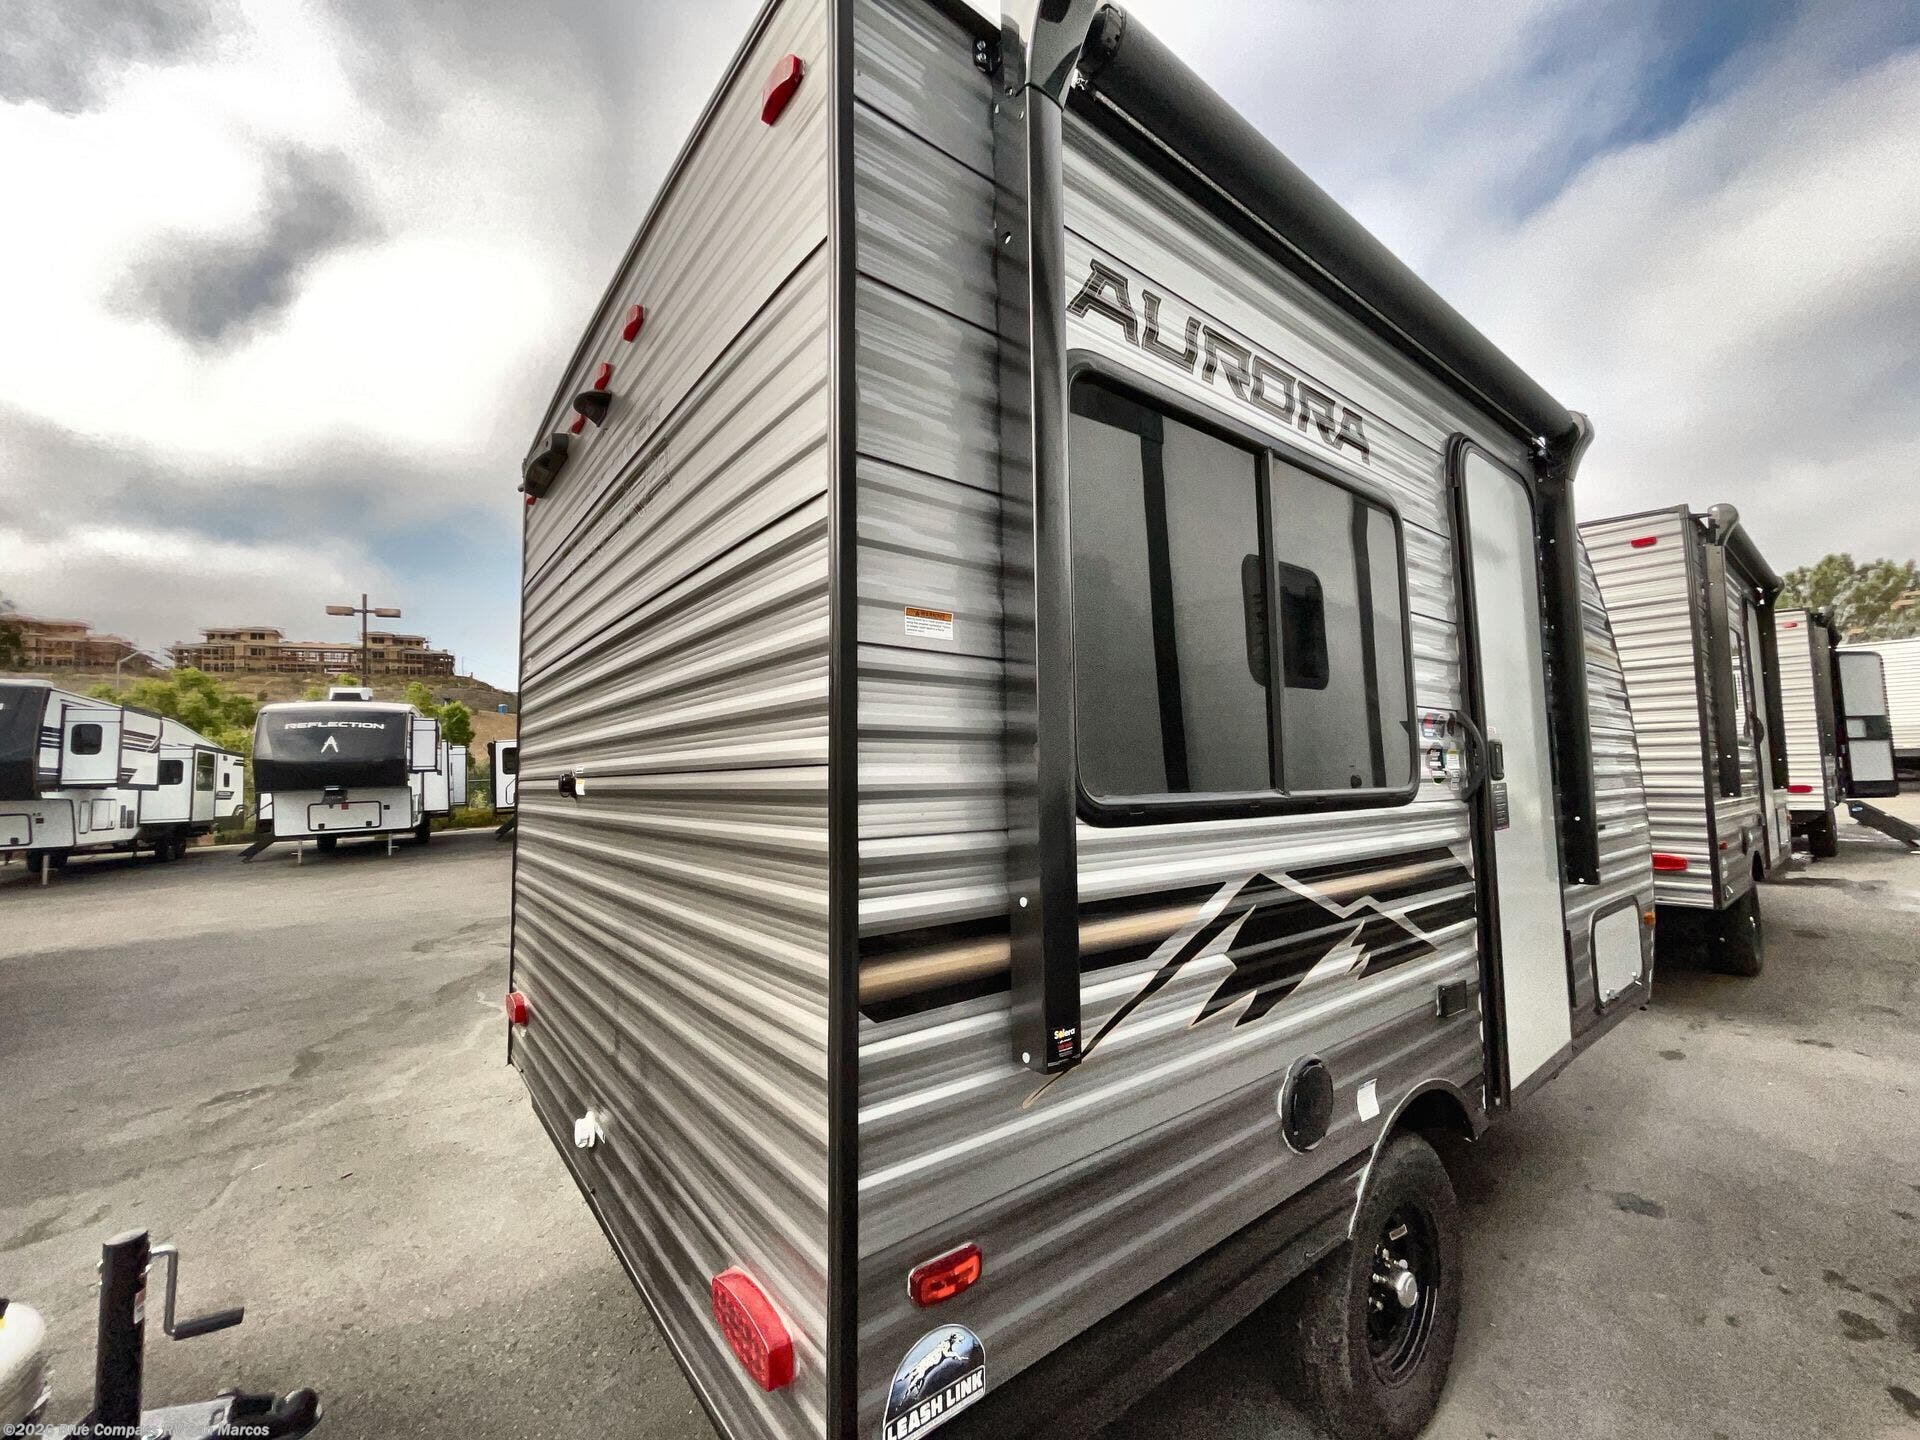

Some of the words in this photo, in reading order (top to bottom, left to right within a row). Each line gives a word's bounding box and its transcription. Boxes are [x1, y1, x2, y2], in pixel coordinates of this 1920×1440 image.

[1065, 258, 1371, 465] AURORA
[284, 721, 385, 730] REFLECTION
[1054, 1028, 1076, 1039] Solera
[886, 1395, 943, 1440] LEASH
[946, 1369, 983, 1409] LINK
